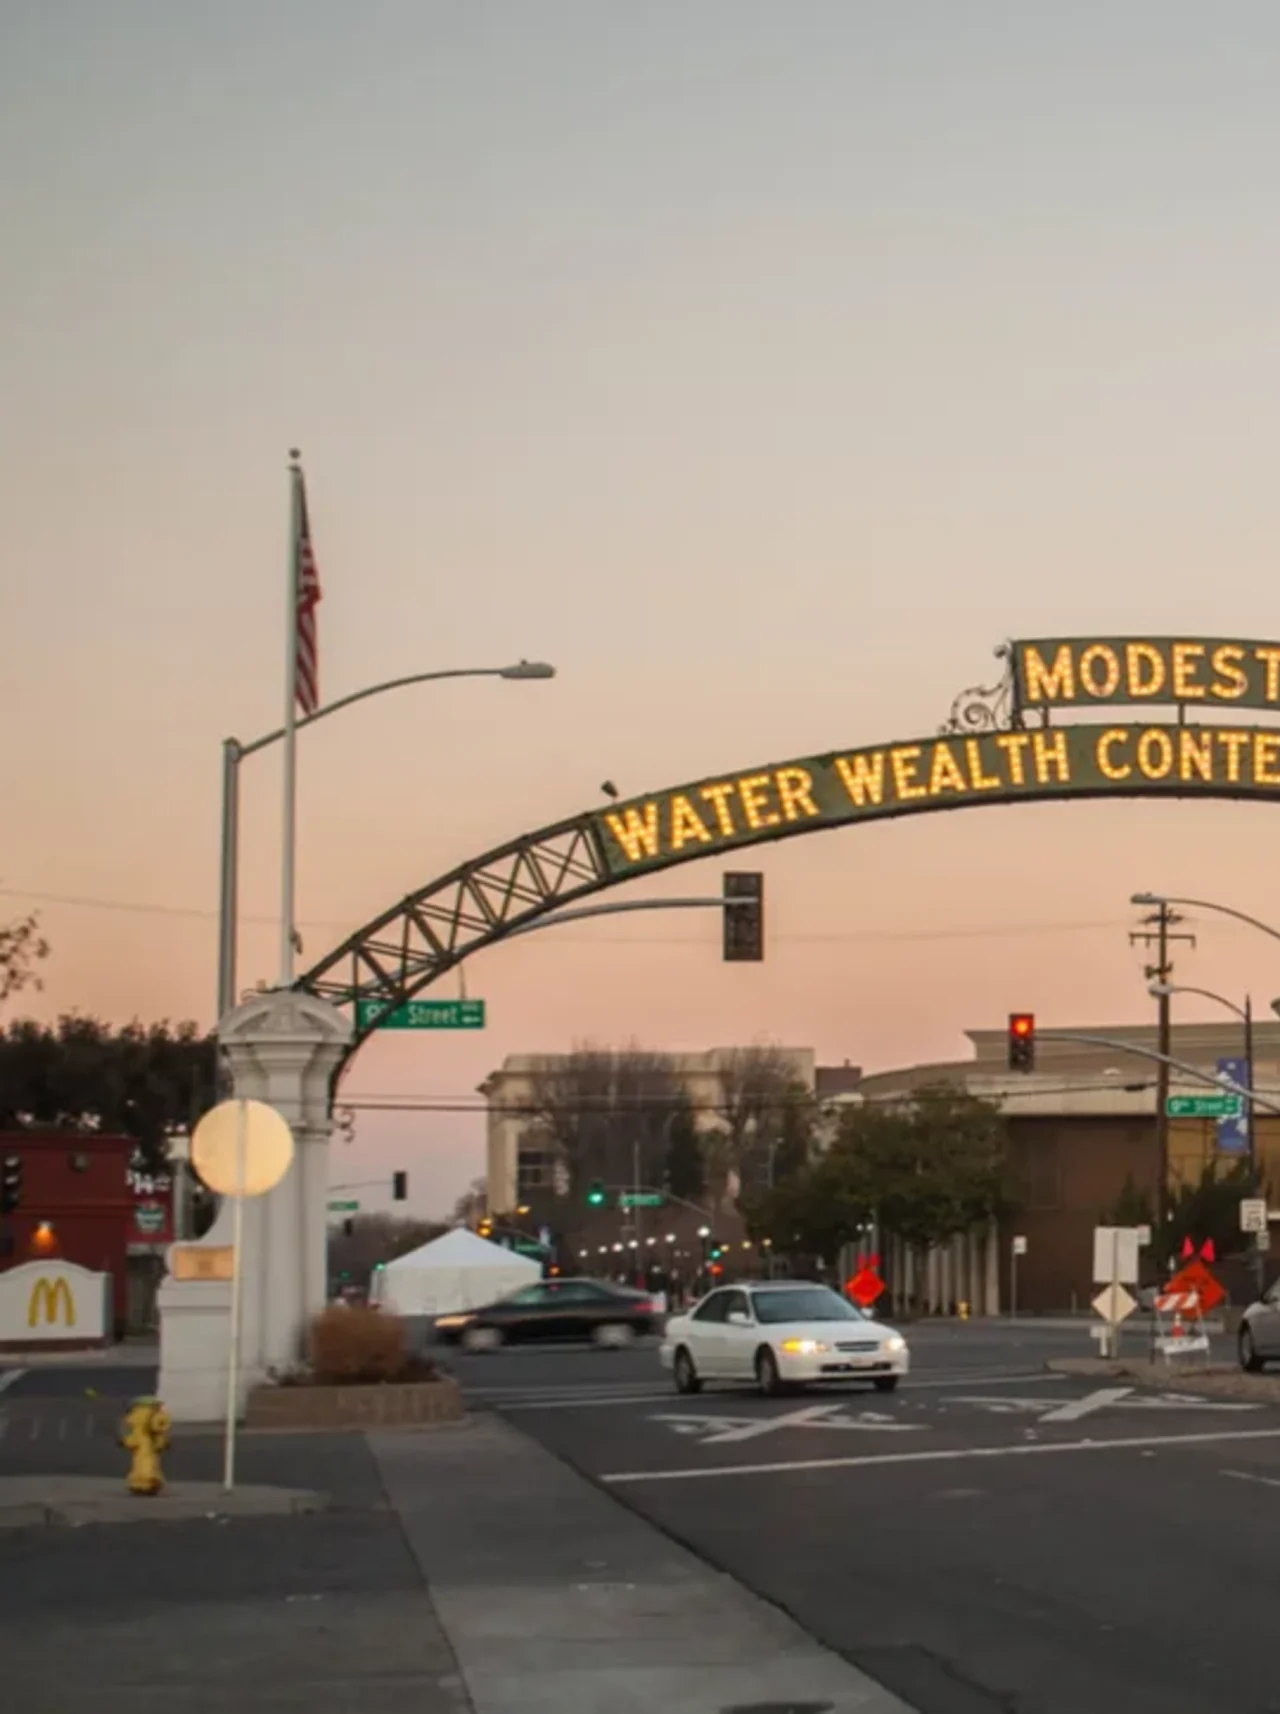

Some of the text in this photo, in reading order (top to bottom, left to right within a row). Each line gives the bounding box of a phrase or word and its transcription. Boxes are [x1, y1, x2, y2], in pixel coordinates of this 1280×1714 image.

[604, 767, 819, 862] WATER
[834, 731, 1071, 823] WEALTH
[407, 1004, 459, 1025] Street
[28, 1276, 76, 1328] M
